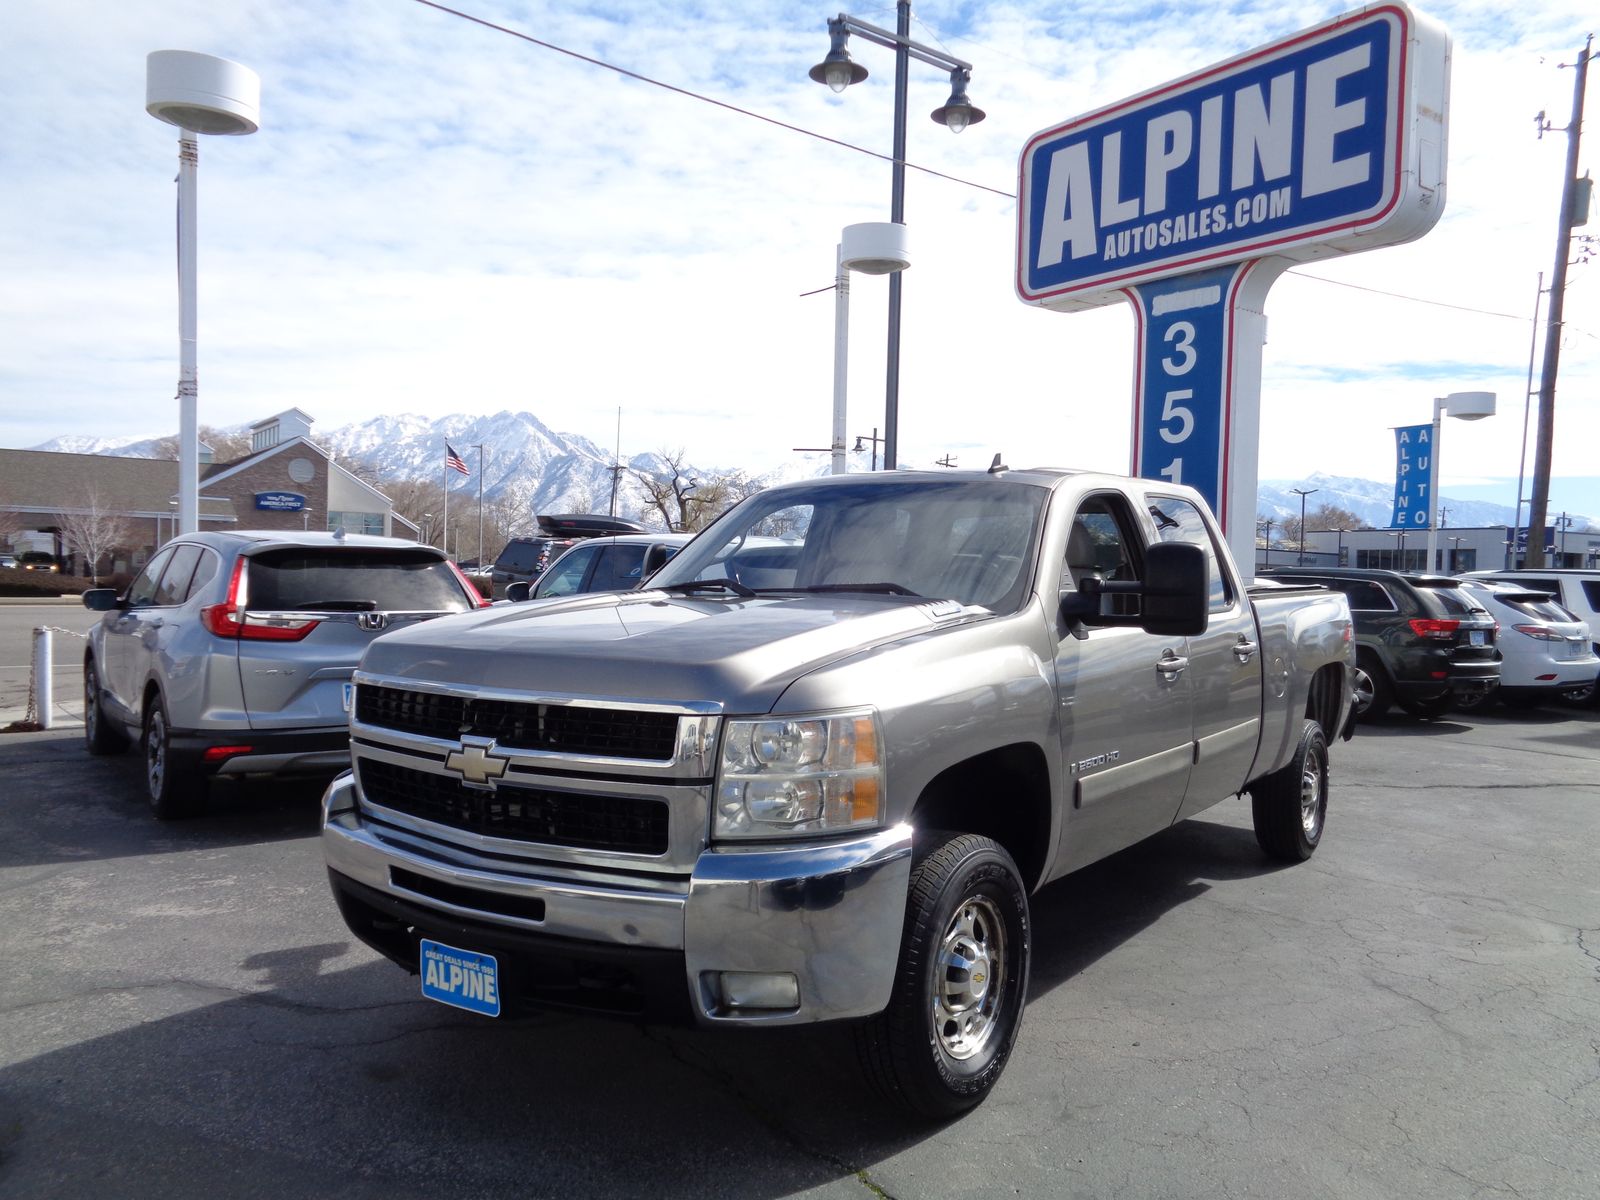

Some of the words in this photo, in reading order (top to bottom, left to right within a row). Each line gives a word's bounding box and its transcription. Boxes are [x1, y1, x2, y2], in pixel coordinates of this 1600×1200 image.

[1037, 42, 1372, 269] ALPINE
[1103, 186, 1292, 262] AUTOSALES.COM
[1397, 431, 1411, 524] ALPINE
[1414, 429, 1429, 524] AUTO
[425, 950, 443, 961] GREAT
[443, 955, 462, 966] DEALS
[463, 960, 480, 971] SINCE
[425, 959, 497, 1004] ALPINE
